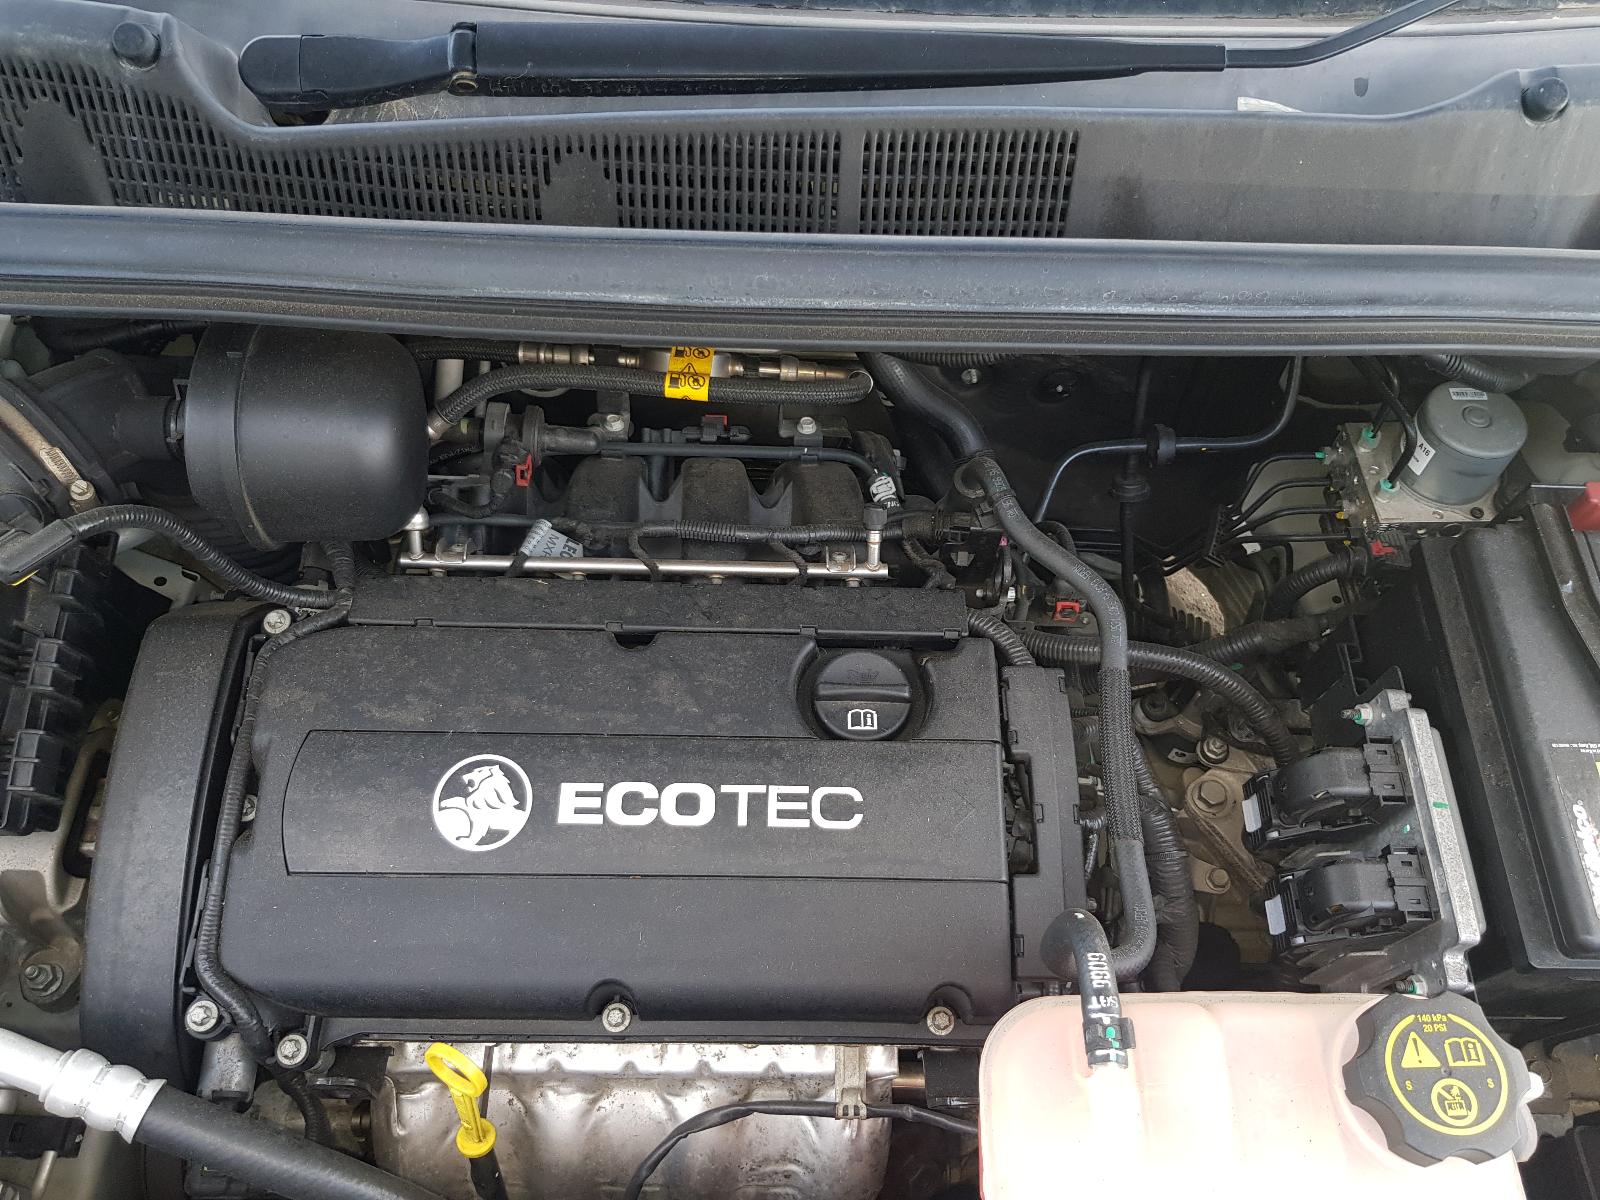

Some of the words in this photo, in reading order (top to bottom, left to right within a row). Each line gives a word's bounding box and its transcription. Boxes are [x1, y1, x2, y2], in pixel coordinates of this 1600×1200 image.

[557, 781, 864, 830] ECOTEC
[1417, 1014, 1431, 1023] 140
[1432, 1013, 1448, 1022] kPa
[1422, 1023, 1433, 1033] 20
[1433, 1023, 1448, 1032] PSI
